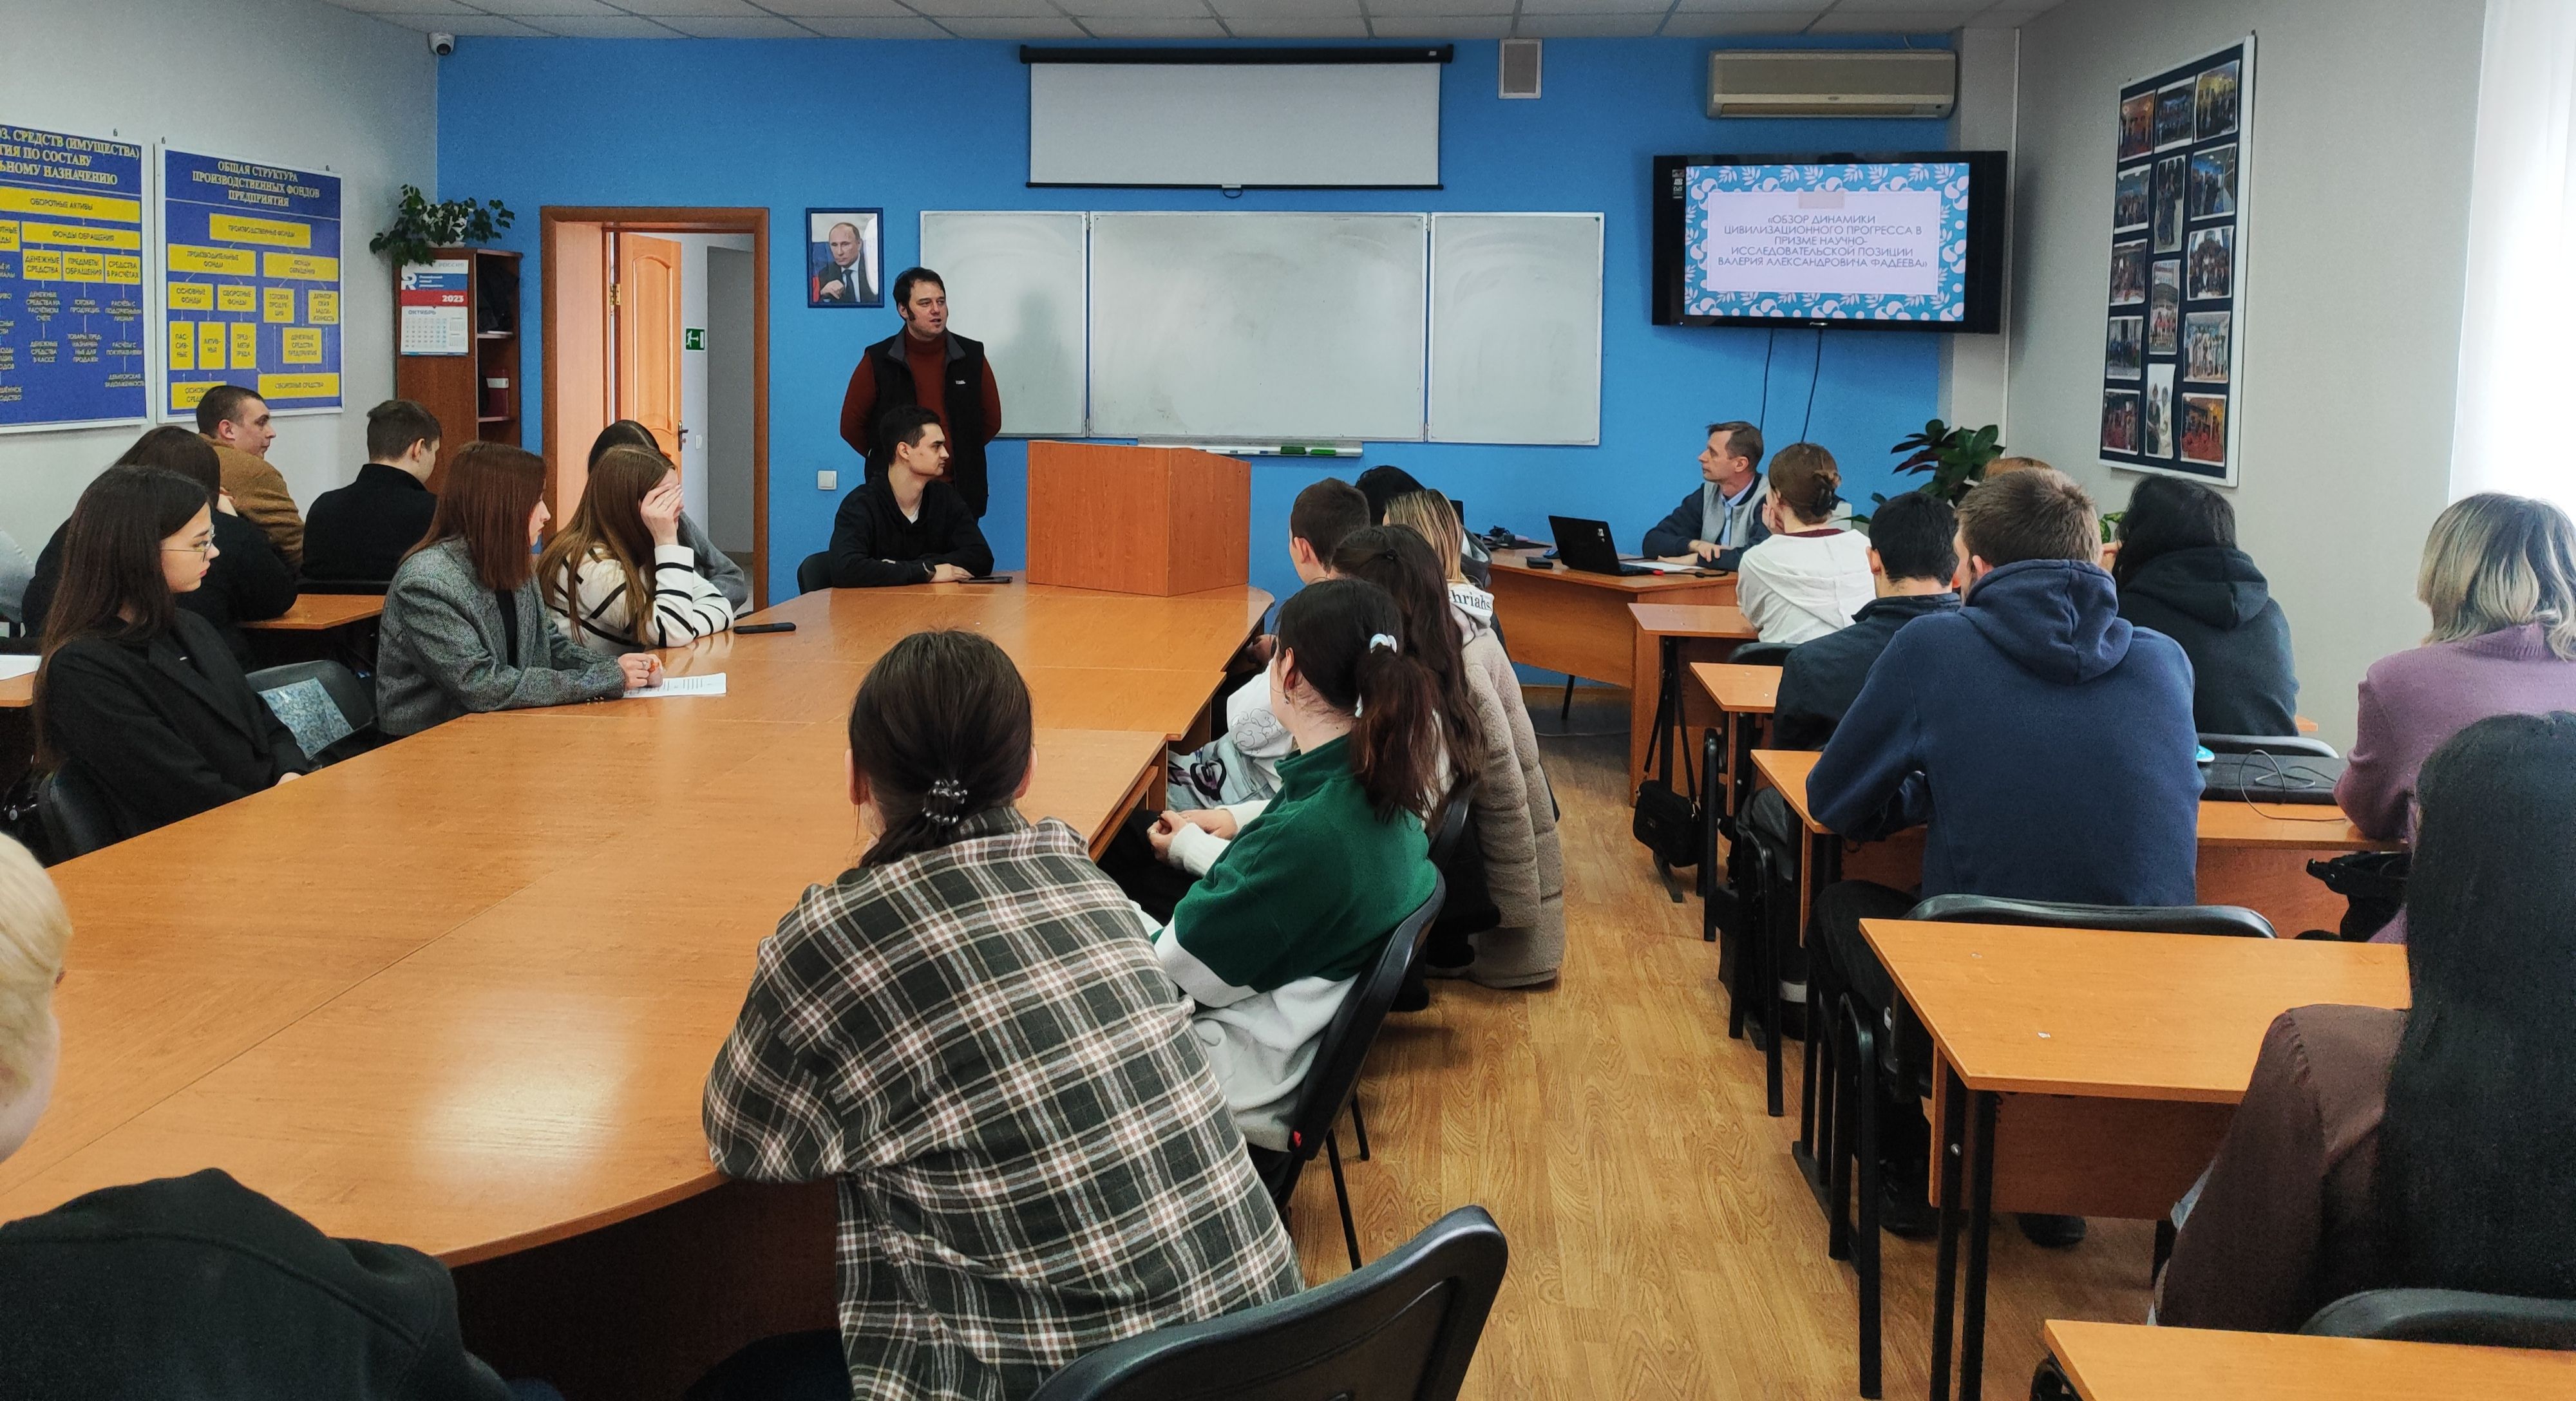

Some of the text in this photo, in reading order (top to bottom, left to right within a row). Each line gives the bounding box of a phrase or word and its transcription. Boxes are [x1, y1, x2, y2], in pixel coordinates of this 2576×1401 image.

[0, 127, 140, 160] З. СРЕДСТВ (ИМУЩЕСТВА)
[23, 147, 40, 160] ПО
[43, 149, 92, 167] СОСТАВУ
[43, 165, 118, 185] НАЗНАЧЕНИЮ
[218, 160, 298, 182] ОБЩАЯ СТРУКТУРА
[193, 170, 320, 198] ПРОИЗВОДСТВЕННЫХ ФОНДОВ
[228, 189, 289, 207] ПРЕДПРИЯТИЯ
[30, 198, 93, 211] ОБОРОТНЫЕ АКТИВЫ
[1768, 214, 1875, 224] «ОБЗОР ДИНАМИКИ
[52, 230, 114, 241] ФОНДЫ ОБРАЩЕНИЯ
[1724, 225, 1922, 235] ЦИВИЛИЗАЦИОННОГО ПРОГРЕССА В
[1775, 236, 1868, 245] ПРИЗМЕ НАУЧНО-
[1731, 245, 1913, 257] ИССЛЕДОВАТЕЛЬСКОЙ ПОЗИЦИИ
[25, 256, 60, 264] ДЕНЕЖНЫЕ
[108, 261, 138, 269] СРЕДСТВА
[1718, 257, 1927, 268] ВАЛЕРИЯ АЛЕКСАНДРОВИЧА ФАДЕЕВА»
[26, 265, 59, 274] СРЕДСТВА
[65, 267, 102, 276] ОБРАЩЕНИЯ
